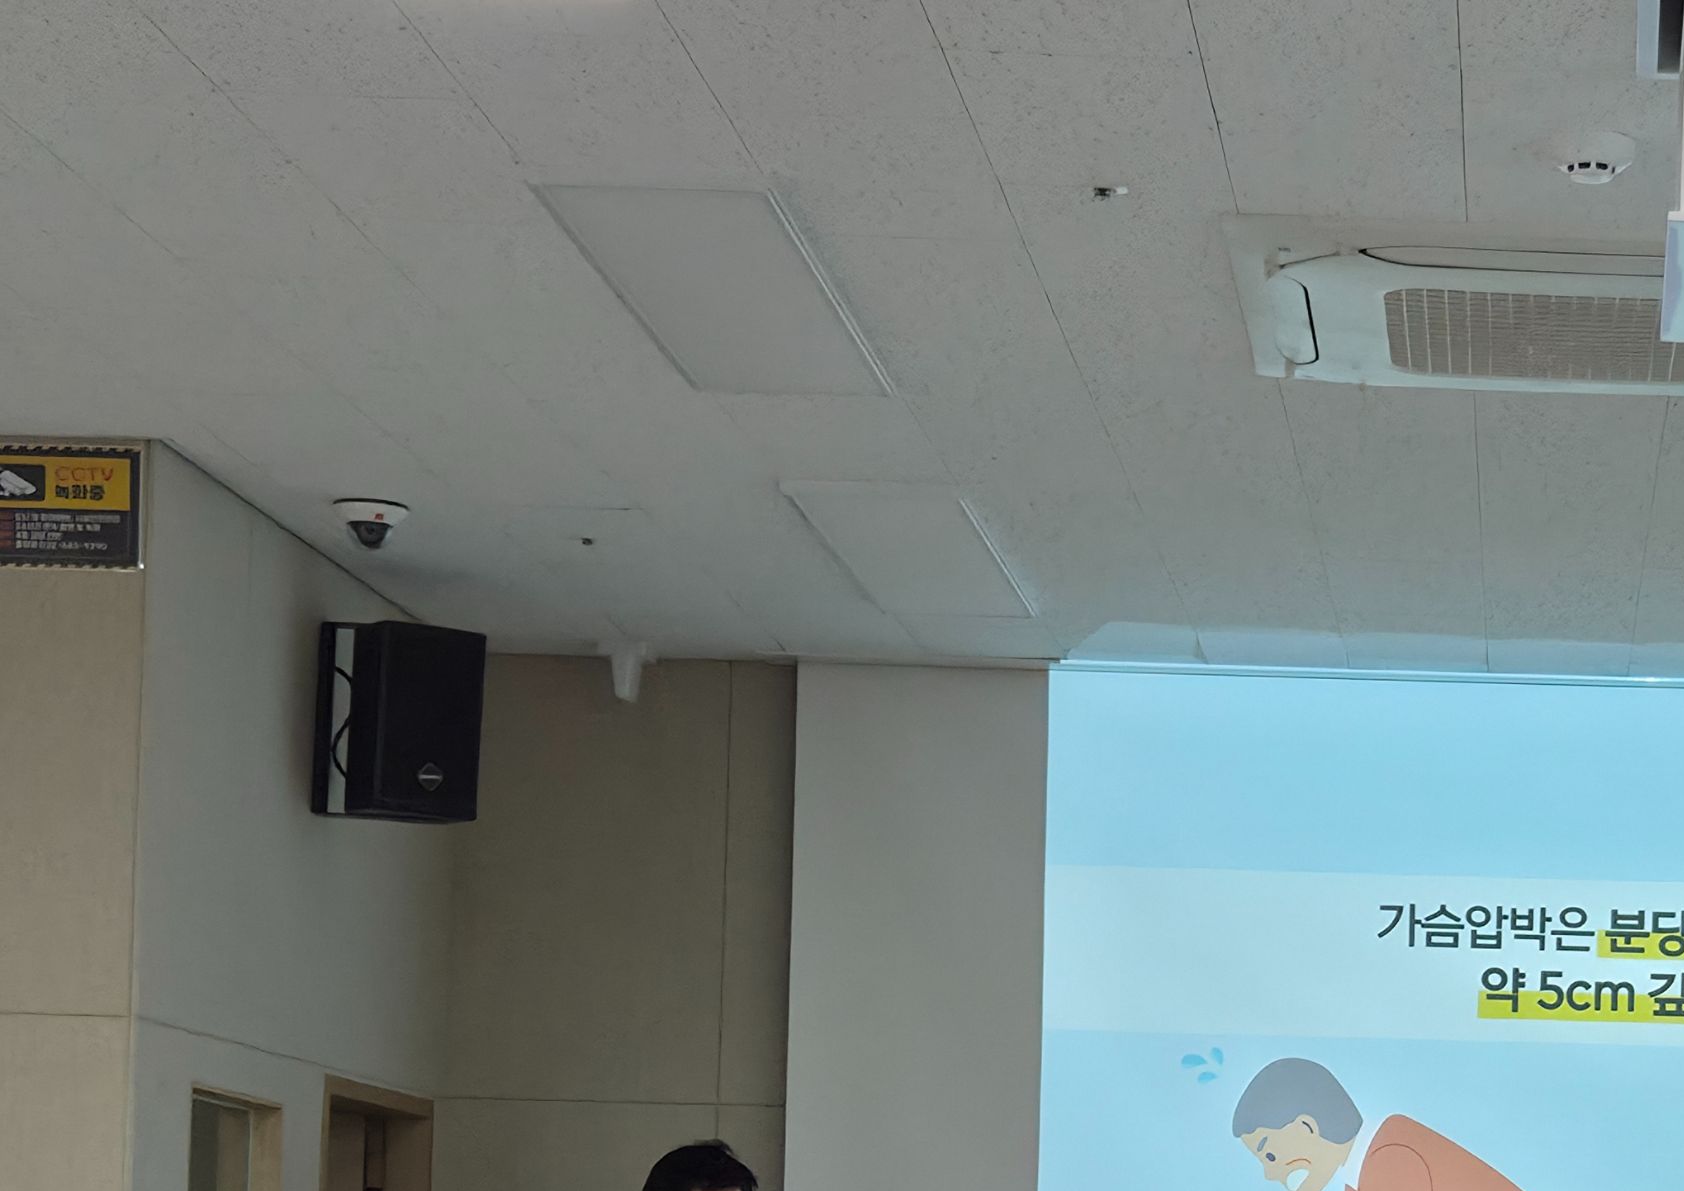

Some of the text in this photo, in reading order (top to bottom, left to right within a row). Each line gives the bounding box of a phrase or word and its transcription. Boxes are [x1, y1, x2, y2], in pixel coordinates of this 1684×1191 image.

[55, 465, 114, 481] CCTV
[55, 484, 105, 501] 녹화중
[1377, 903, 1594, 953] 가슴압박은
[1481, 967, 1526, 1013] 약
[1537, 970, 1636, 1013] 5cm
